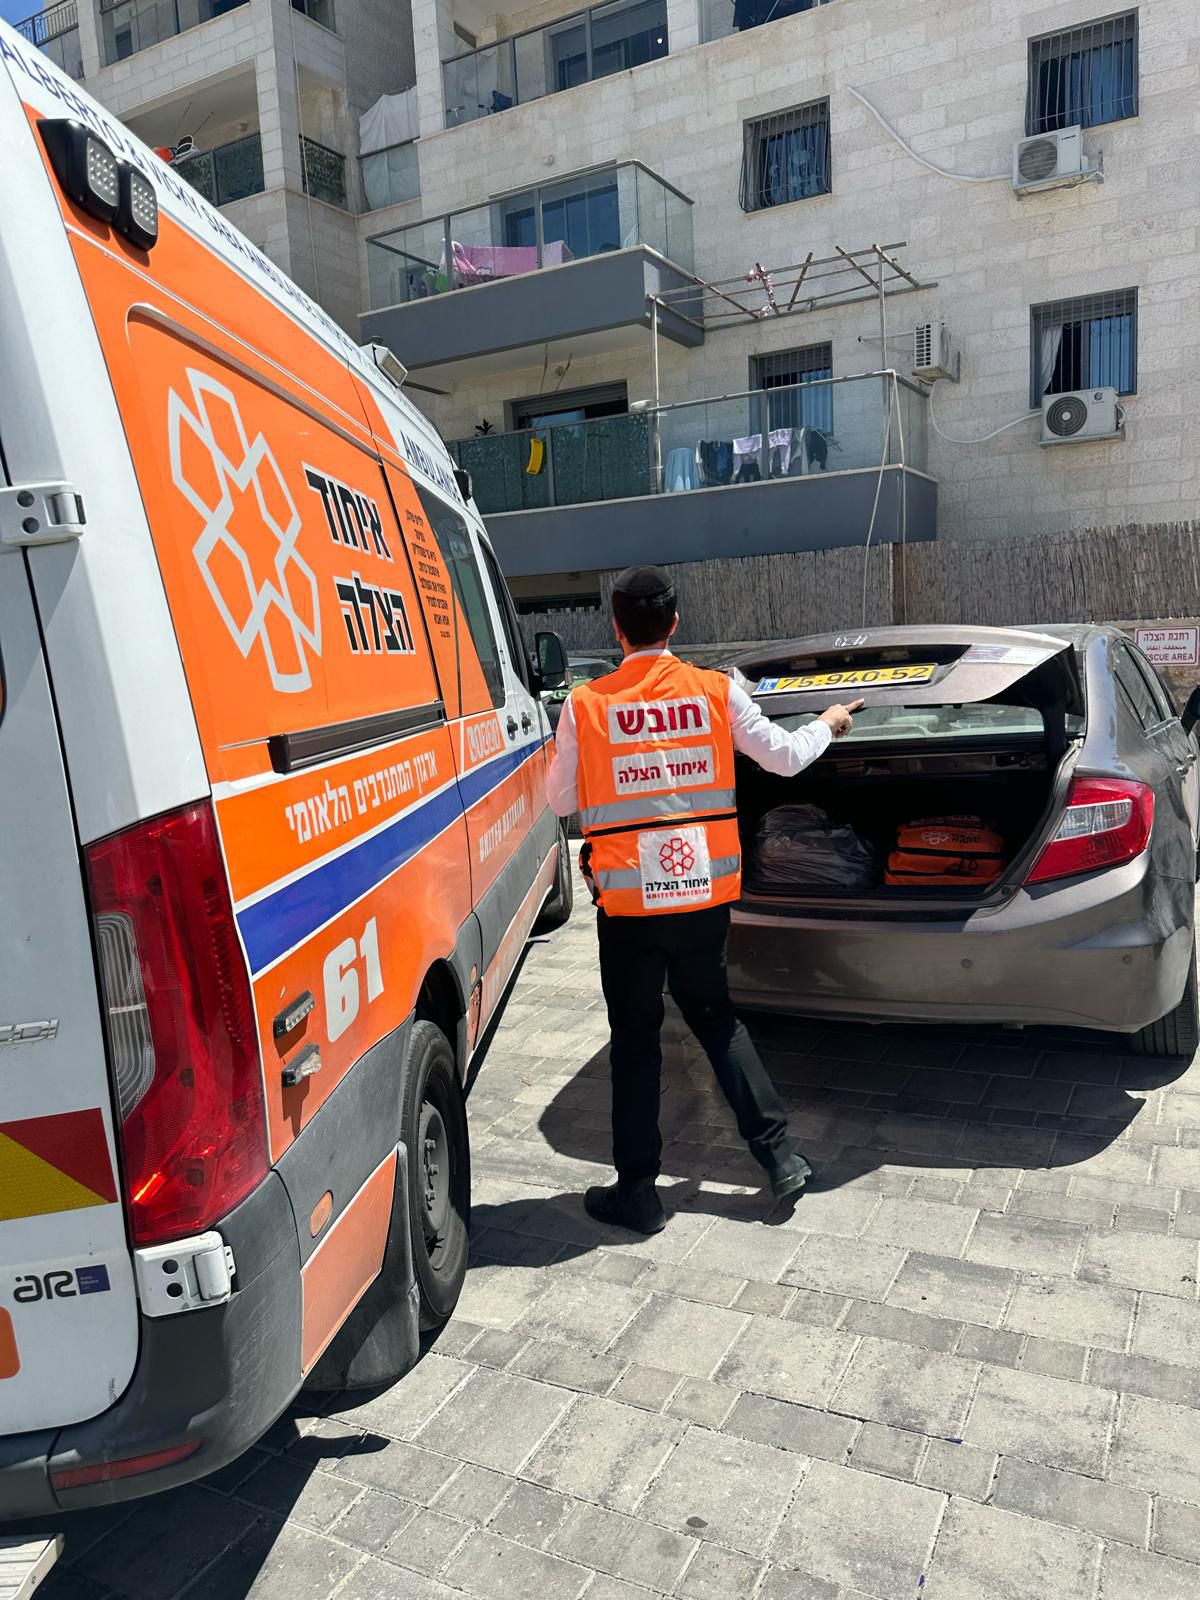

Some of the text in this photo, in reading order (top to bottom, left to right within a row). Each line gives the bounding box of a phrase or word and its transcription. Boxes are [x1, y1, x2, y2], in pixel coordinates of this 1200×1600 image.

[0, 36, 125, 152] ALBERTO
[125, 139, 148, 172] &
[142, 152, 203, 219] VICKY
[200, 205, 249, 259] SABA
[303, 464, 393, 562] איחוד
[333, 572, 416, 654] הצלה
[1143, 632, 1190, 641] רחבת הצלה
[1171, 653, 1194, 661] AREA
[616, 703, 703, 735] חובש
[618, 760, 708, 784] איחוד הצלה
[285, 750, 438, 844] ארגון המתנדבים הלאומי
[645, 877, 709, 892] איחוד הצלה
[646, 891, 674, 899] UNITED
[323, 916, 384, 1043] 61
